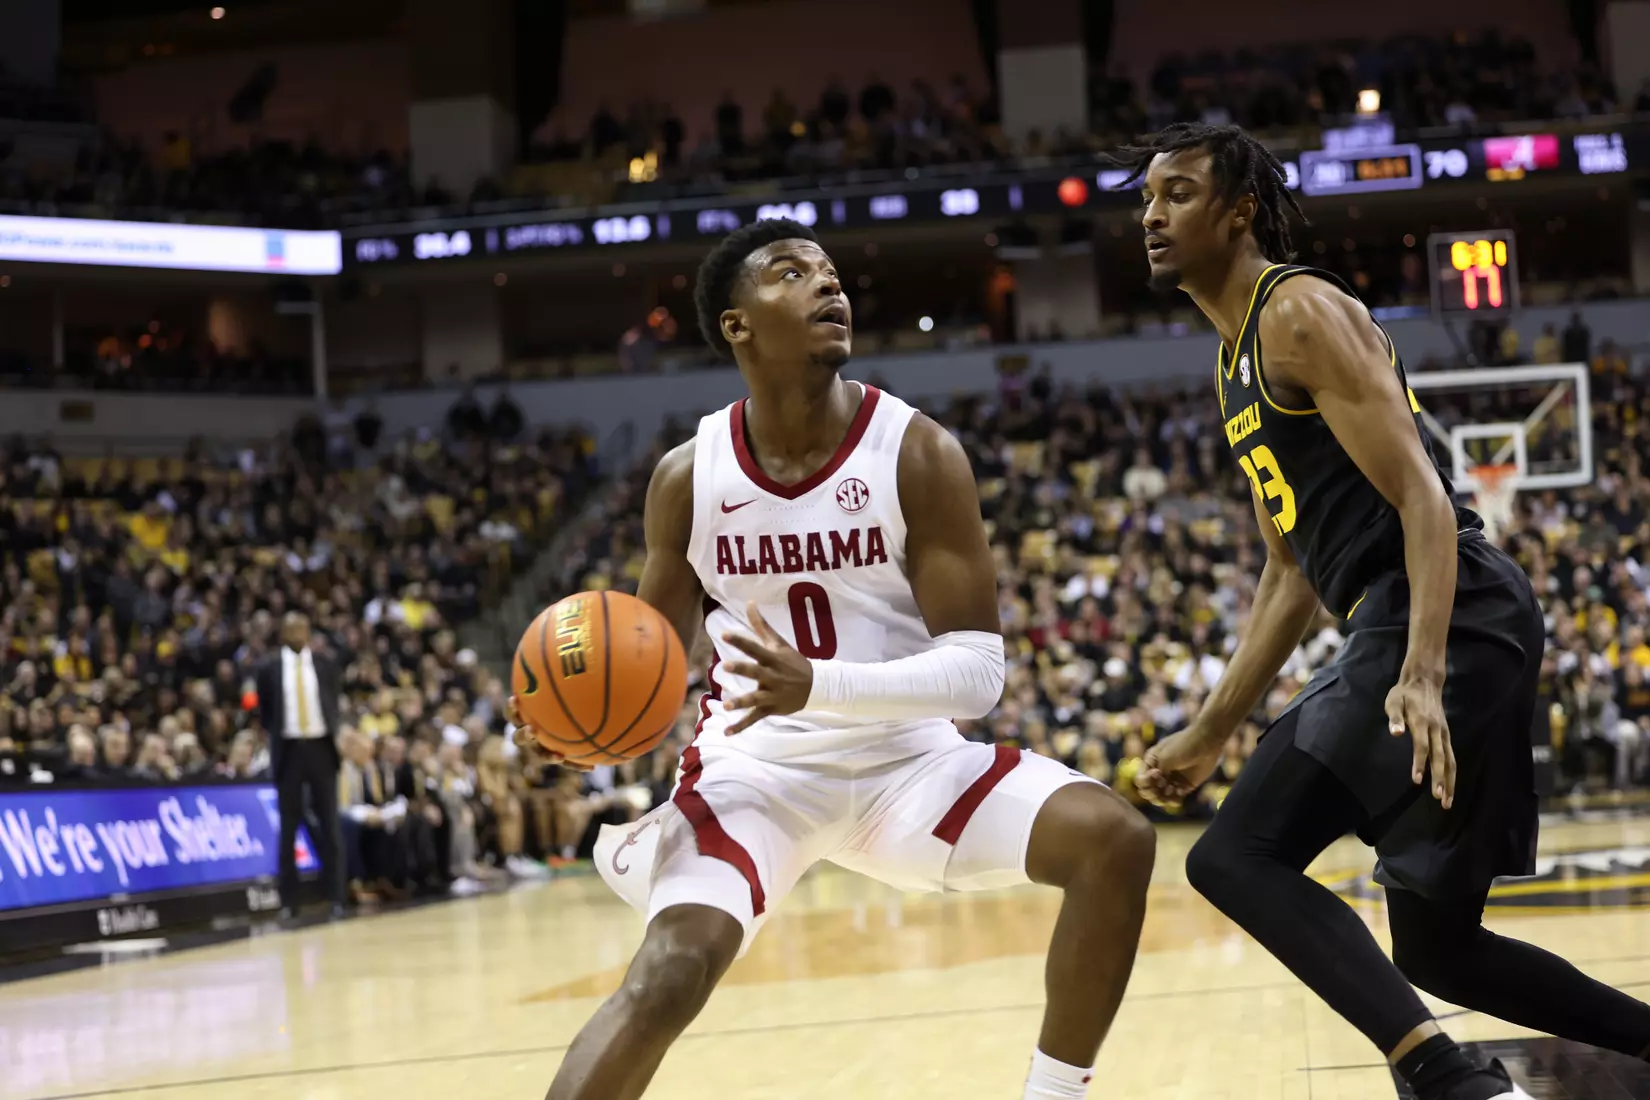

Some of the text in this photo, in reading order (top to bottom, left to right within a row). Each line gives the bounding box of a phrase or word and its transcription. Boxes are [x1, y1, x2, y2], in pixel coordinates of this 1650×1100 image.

[837, 479, 869, 511] SEC
[716, 526, 888, 575] ALABAMA
[788, 581, 837, 660] 0
[0, 806, 104, 878] We're
[96, 818, 169, 888] your
